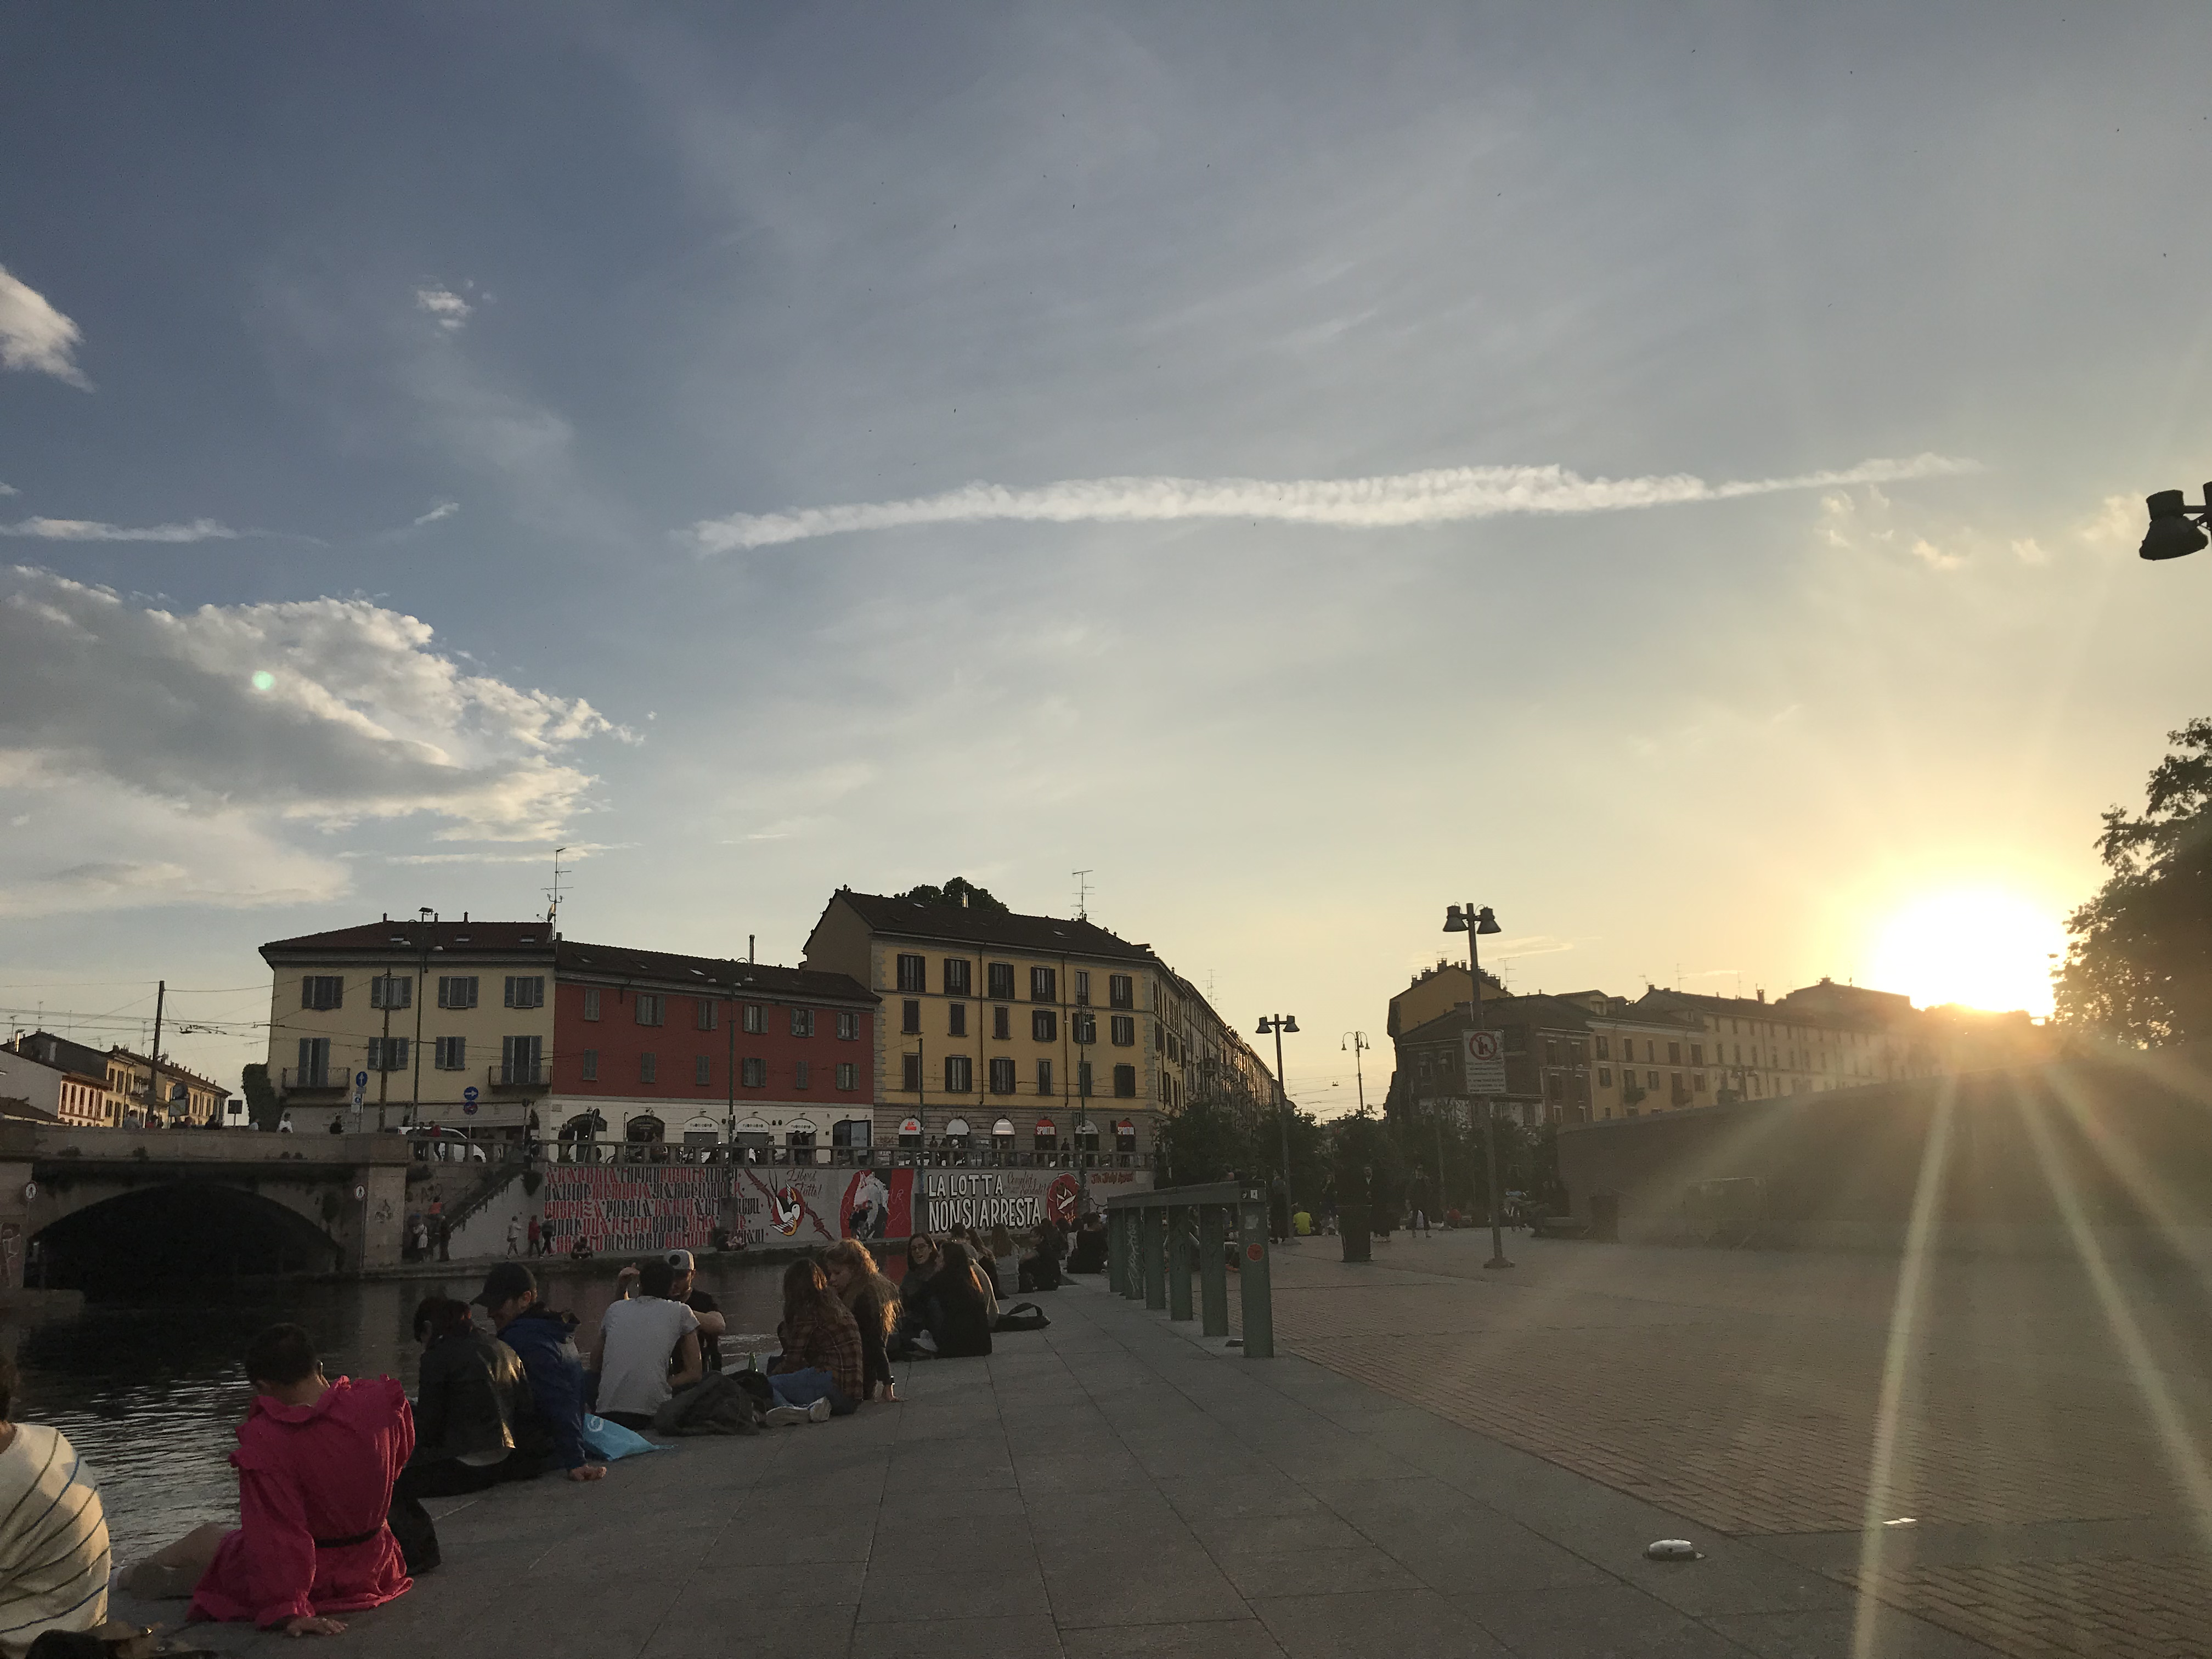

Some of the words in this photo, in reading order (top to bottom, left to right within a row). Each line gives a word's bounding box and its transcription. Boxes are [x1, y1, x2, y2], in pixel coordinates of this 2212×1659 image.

[928, 1174, 946, 1197] LA
[950, 1173, 1004, 1197] LOTTA
[928, 1199, 960, 1233] NON
[961, 1197, 977, 1229] SI
[978, 1197, 1042, 1231] ARRESTA
